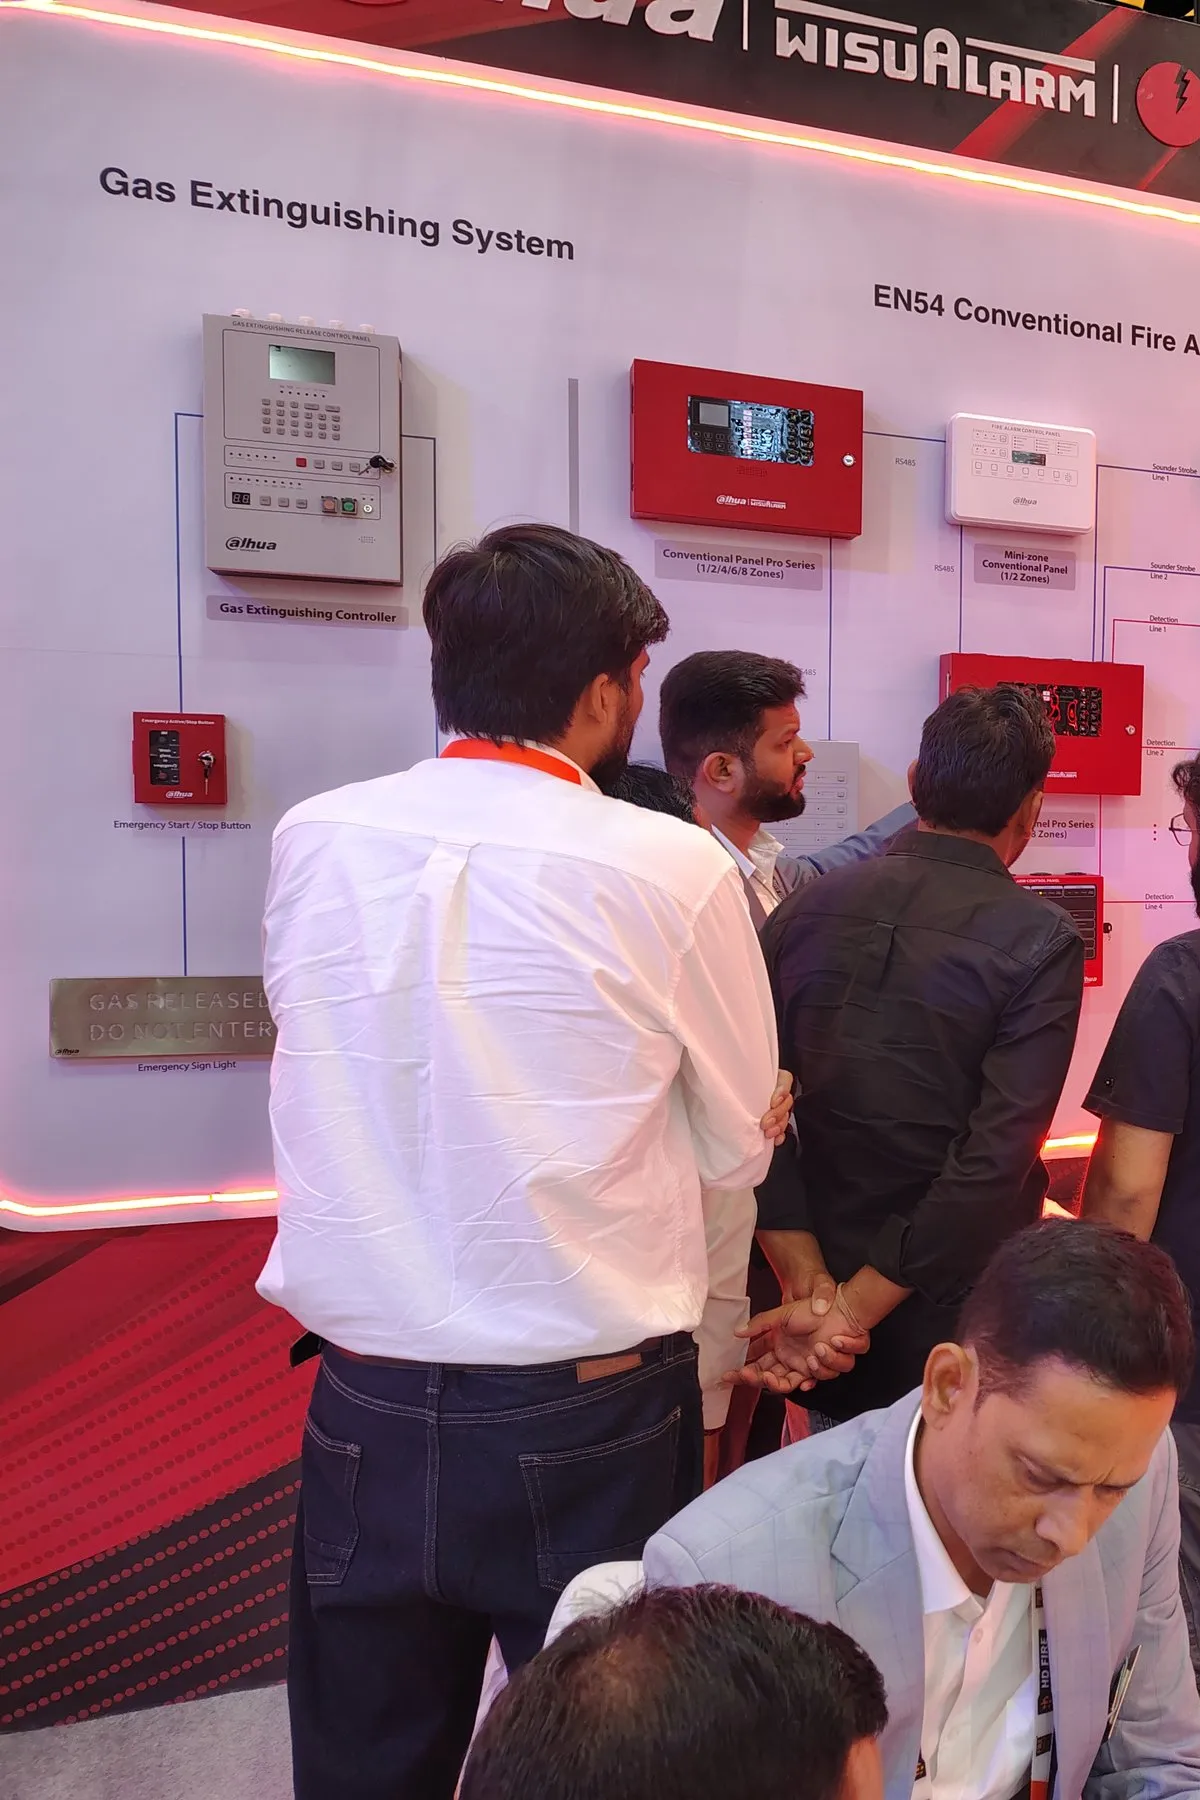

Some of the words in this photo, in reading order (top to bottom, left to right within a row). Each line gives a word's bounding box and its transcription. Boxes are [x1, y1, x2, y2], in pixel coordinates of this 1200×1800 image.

[99, 166, 176, 203] Gas
[190, 179, 440, 247] Extinguishing
[452, 218, 574, 260] System
[874, 284, 945, 317] EN54
[953, 297, 1122, 344] Conventional
[1131, 324, 1176, 352] Fire
[895, 457, 916, 467] RS485
[1152, 463, 1177, 473] Sounder
[1178, 466, 1198, 474] Strobe
[663, 549, 734, 564] Conventional
[735, 554, 764, 566] Panel
[766, 558, 784, 568] Pro
[785, 559, 816, 571] Series
[1004, 551, 1049, 563] Mini-zone
[696, 563, 748, 576] (1/2/4/6/8
[750, 566, 784, 580] Zones)
[934, 564, 955, 574] RS485
[982, 559, 1042, 573] Conventional
[1043, 565, 1068, 575] Panel
[1150, 562, 1175, 571] Sounder
[1176, 564, 1196, 572] Strobe
[1000, 572, 1019, 583] (1/2
[1020, 574, 1050, 585] Zones)
[220, 603, 244, 614] Gas
[246, 604, 333, 621] Extinguishing
[335, 610, 397, 623] Controller
[1149, 615, 1179, 623] Detection
[1149, 625, 1163, 633] Line
[1146, 739, 1176, 747] Detection
[113, 820, 166, 831] Emergency
[168, 821, 190, 829] Start
[197, 821, 219, 830] Stop
[221, 822, 251, 830] Button
[1034, 820, 1050, 828] nel
[1051, 820, 1067, 828] Pro
[1068, 820, 1094, 829] Series
[1038, 830, 1067, 839] Zones)
[90, 993, 137, 1011] GAS
[90, 1023, 124, 1041] DO
[134, 1022, 186, 1041] NOT
[192, 1021, 272, 1040] ENTER
[138, 1062, 190, 1073] Emergency
[191, 1062, 211, 1071] Sign
[213, 1061, 237, 1071] Light
